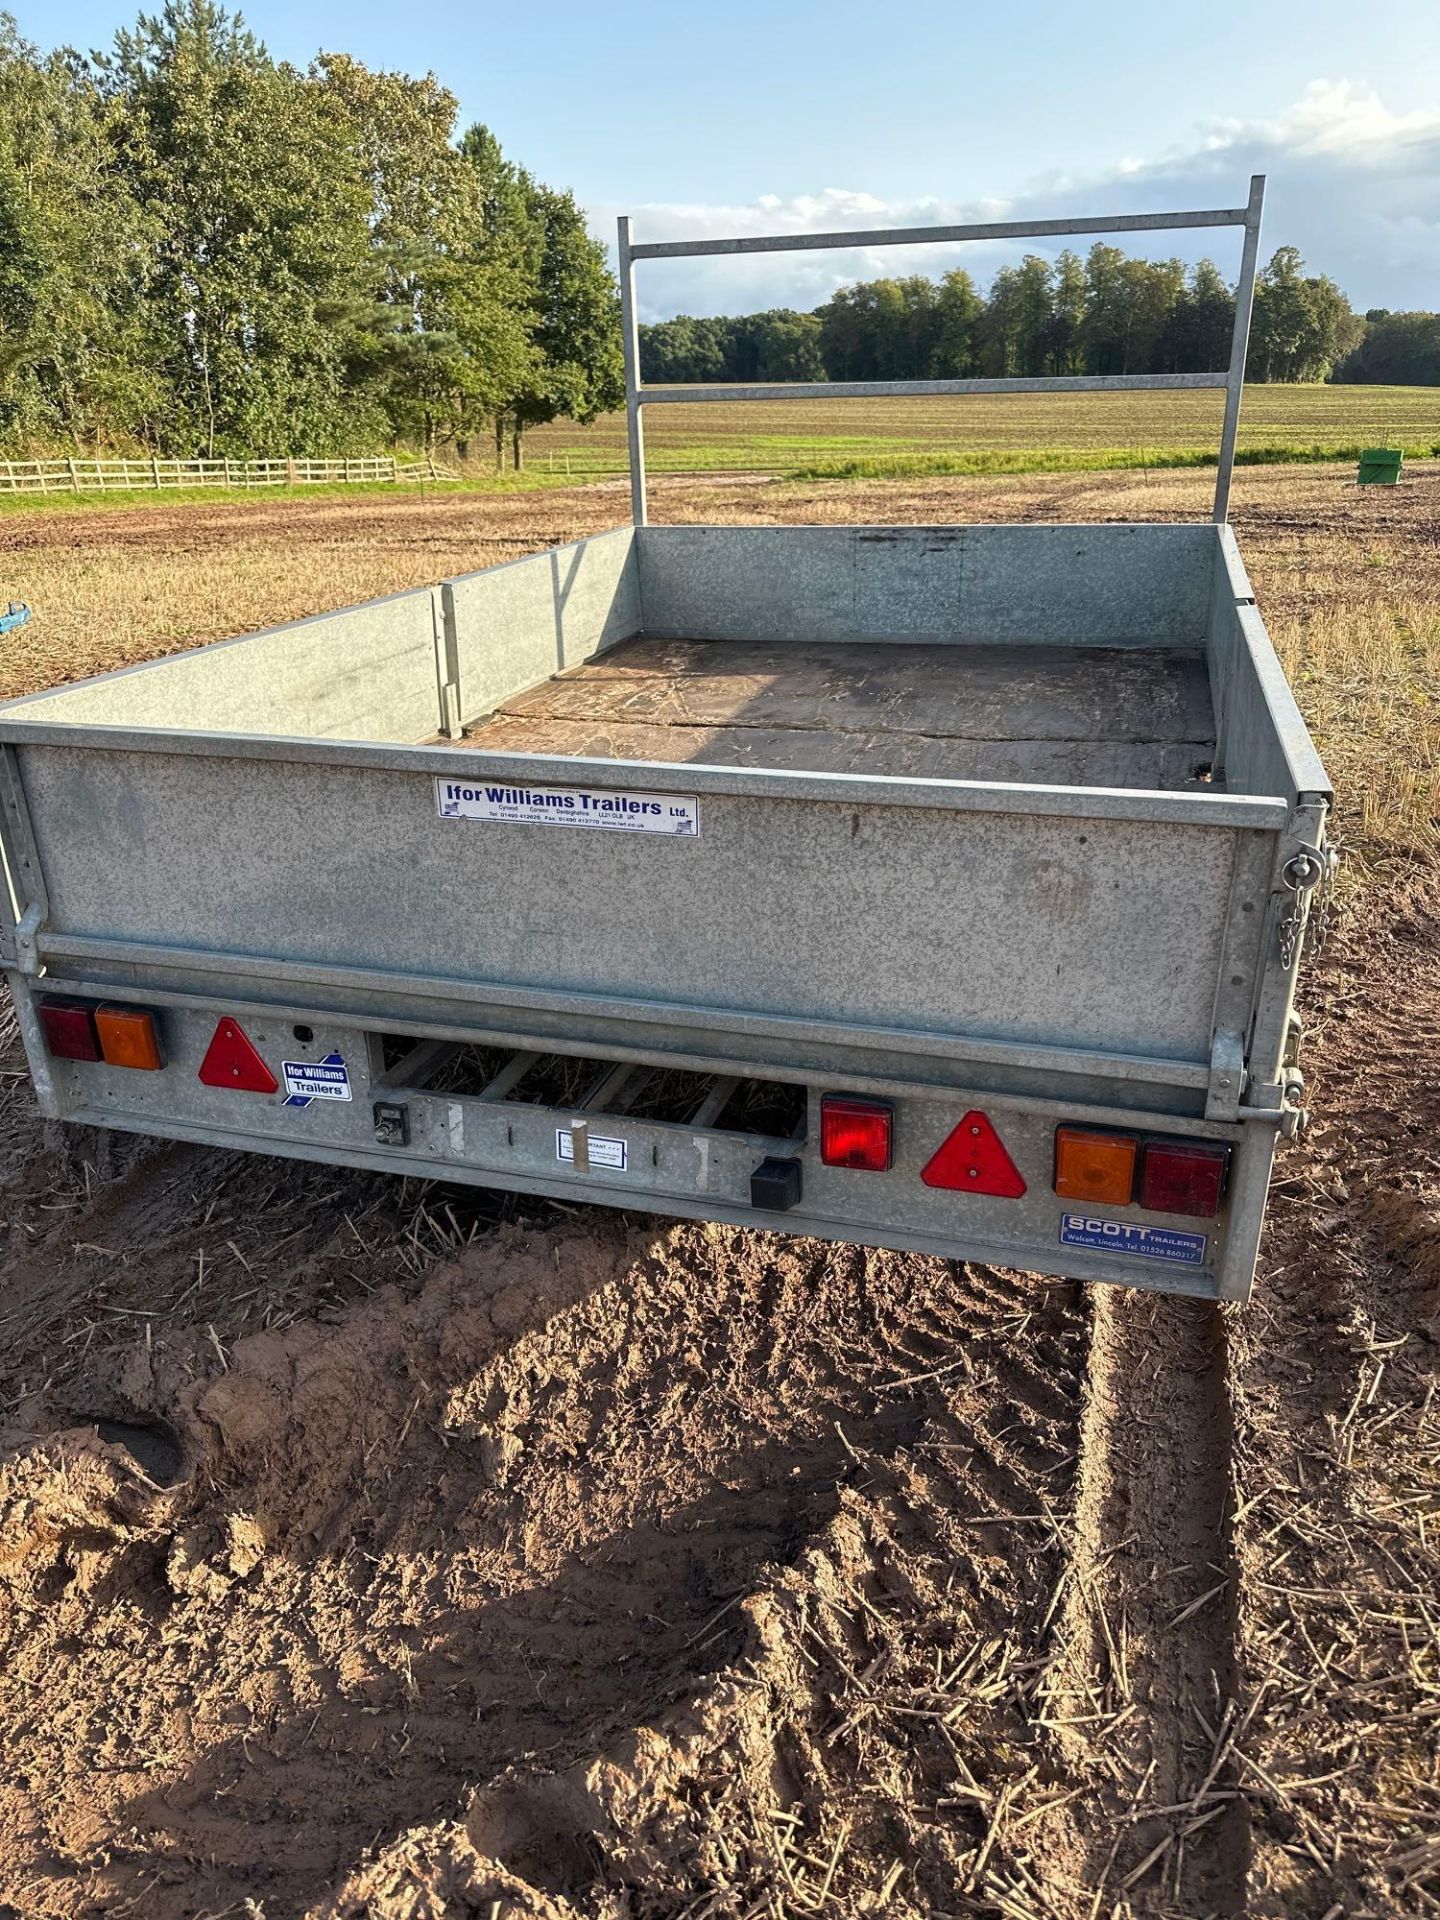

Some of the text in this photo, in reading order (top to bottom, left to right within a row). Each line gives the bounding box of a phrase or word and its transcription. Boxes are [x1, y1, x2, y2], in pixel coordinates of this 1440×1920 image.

[447, 785, 689, 817] Ifor Williams Trailers Ltd.
[287, 1065, 344, 1080] Ifor Williams
[294, 1081, 342, 1095] Trailers
[1068, 1217, 1197, 1248] SCOTT TRAILERS
[1140, 1245, 1165, 1255] 01526
[1166, 1249, 1195, 1259] 860317
